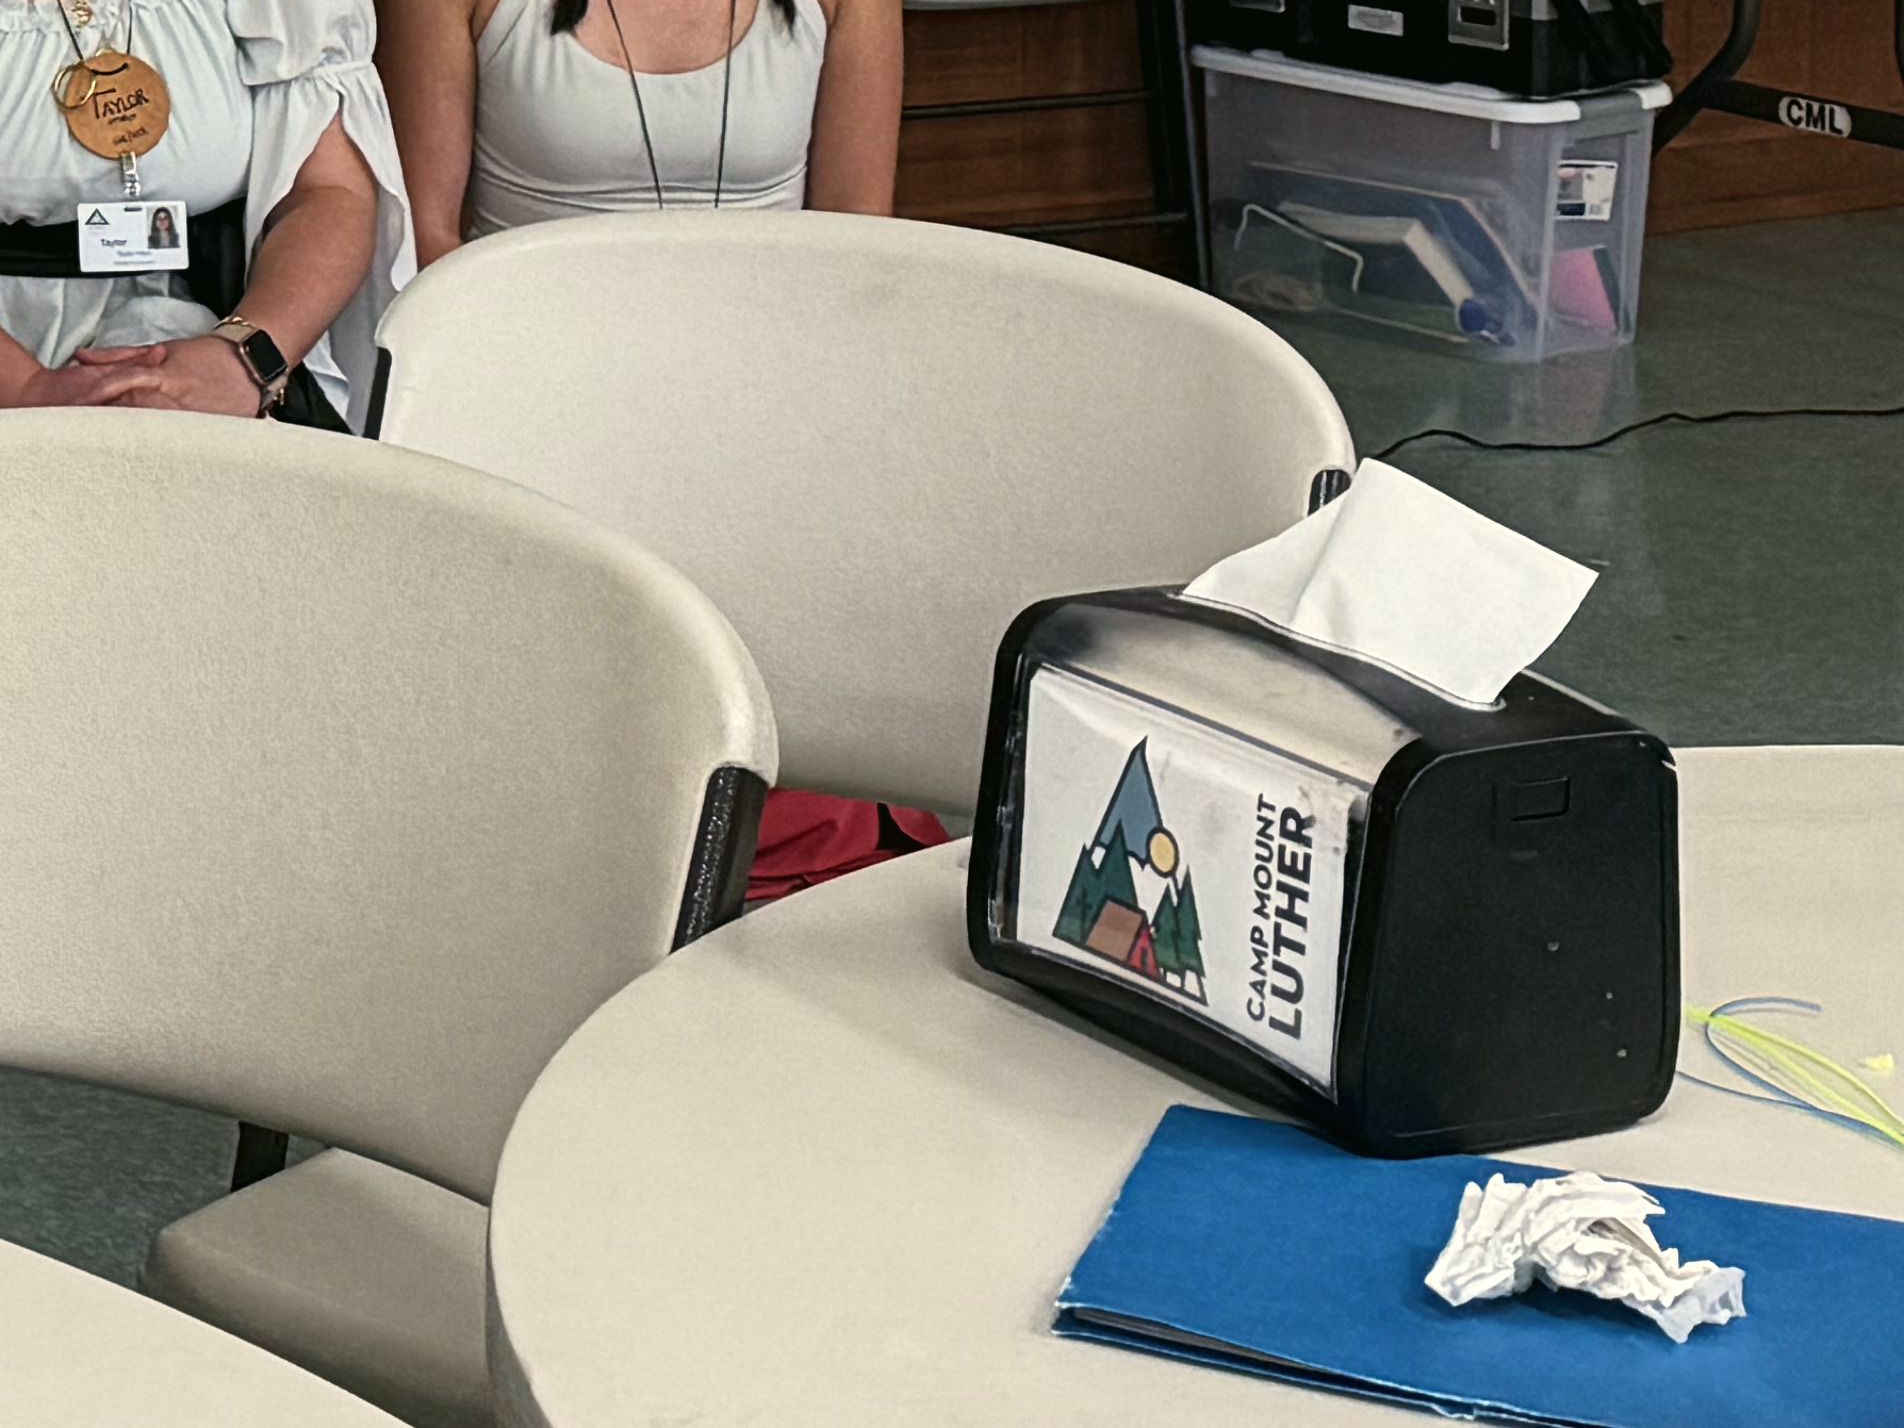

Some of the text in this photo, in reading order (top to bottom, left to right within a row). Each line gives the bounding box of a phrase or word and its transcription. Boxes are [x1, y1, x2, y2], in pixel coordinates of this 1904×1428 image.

[1786, 97, 1845, 136] CML
[1246, 791, 1277, 1023] CAMP MOUNT
[1268, 805, 1314, 1041] LUTHER
